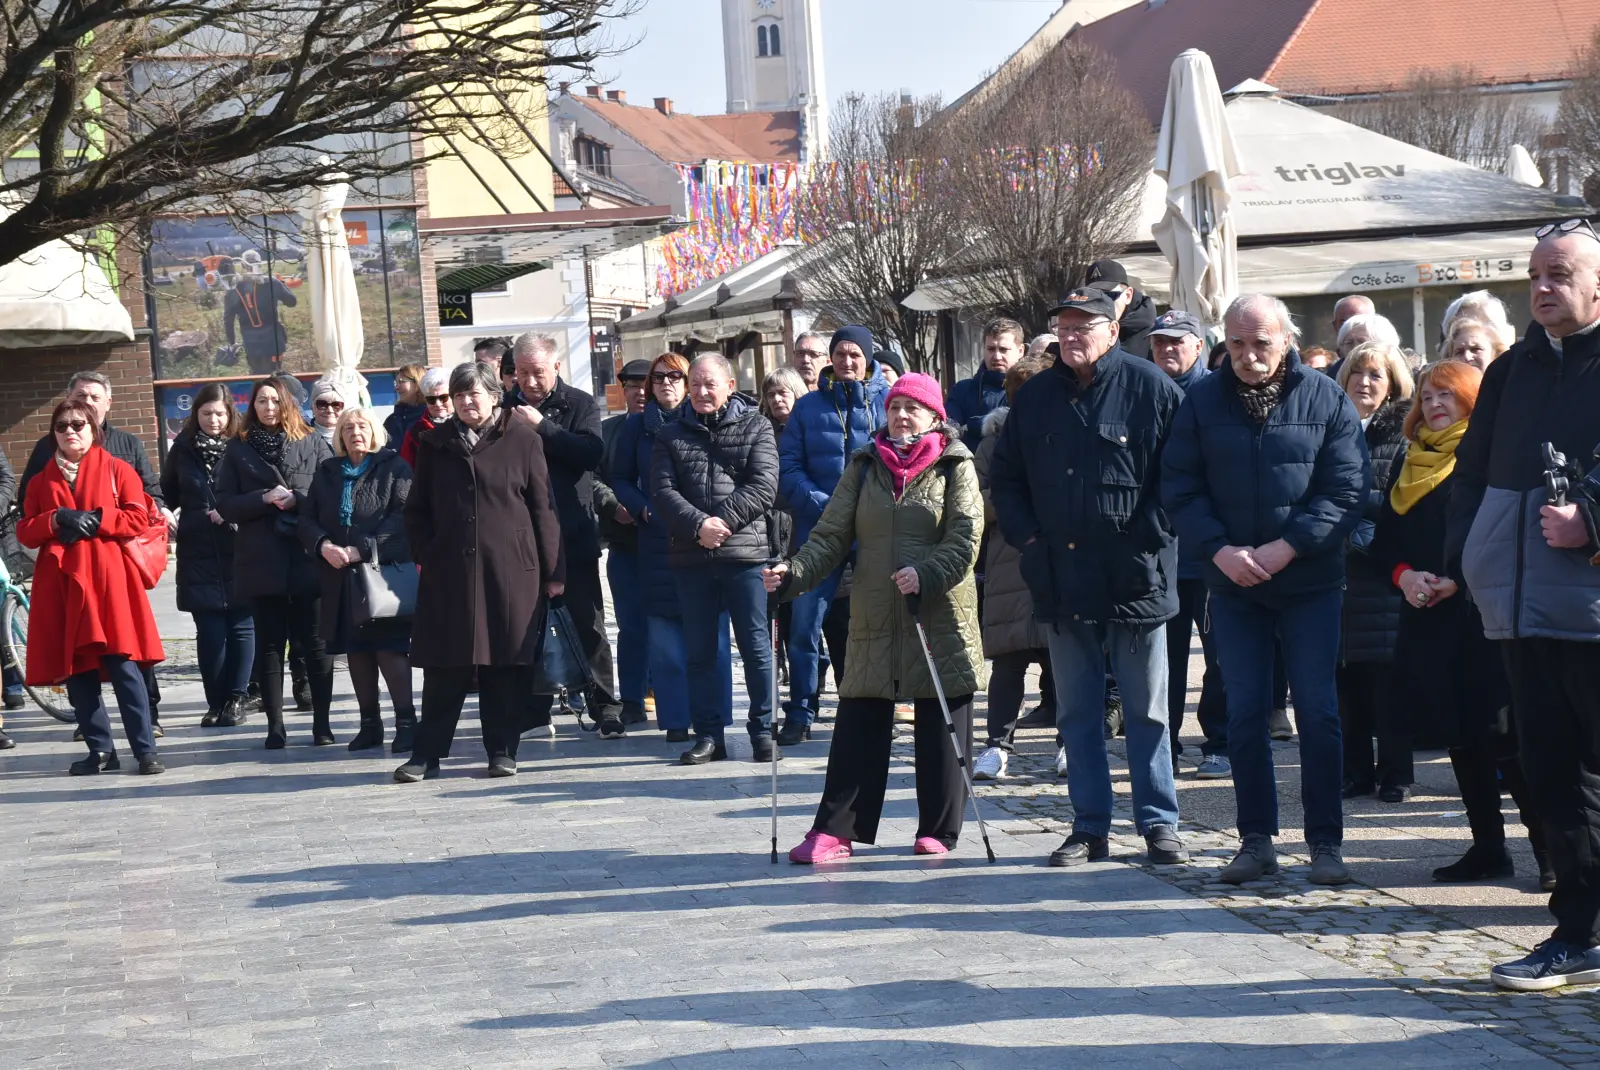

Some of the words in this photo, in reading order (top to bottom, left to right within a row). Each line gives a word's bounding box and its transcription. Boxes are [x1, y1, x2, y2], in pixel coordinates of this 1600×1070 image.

[1274, 162, 1405, 185] triglav
[1296, 195, 1377, 205] OSIGURANJE
[1384, 272, 1406, 284] bar
[1499, 260, 1513, 275] 3
[439, 307, 468, 319] TA
